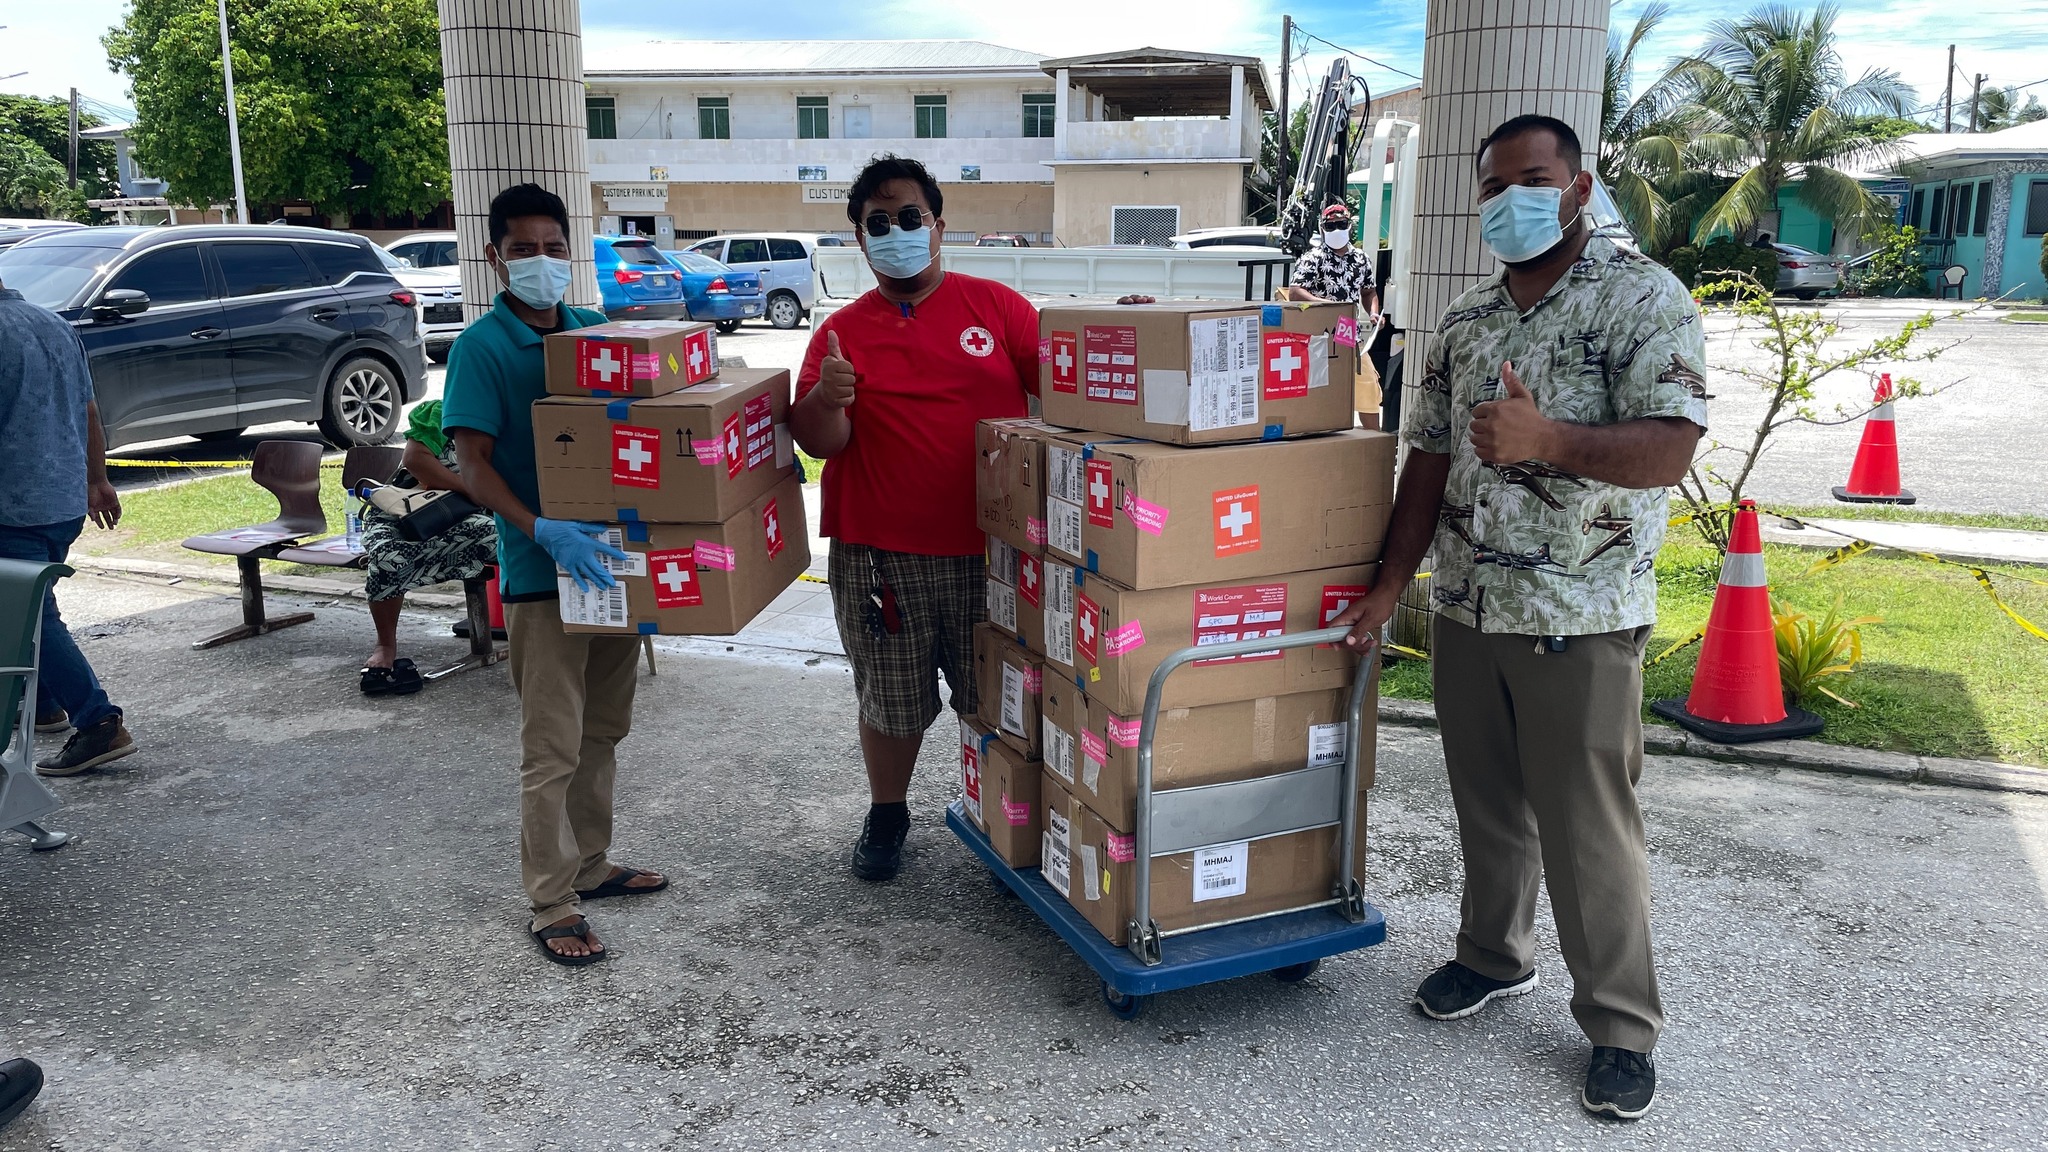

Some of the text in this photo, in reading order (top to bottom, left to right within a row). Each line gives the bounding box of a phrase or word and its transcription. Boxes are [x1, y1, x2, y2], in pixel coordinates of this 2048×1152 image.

[602, 188, 631, 198] CUSTOMER
[1337, 322, 1353, 340] PA
[1215, 490, 1258, 503] UNITED LifeGuard
[1124, 494, 1136, 516] PA
[1136, 505, 1161, 521] PRIORITY
[1207, 593, 1244, 602] World Courier
[1105, 637, 1116, 651] PA
[1108, 720, 1120, 739] PA
[1081, 733, 1091, 750] PA
[1315, 750, 1344, 761] MHMAJ
[1108, 838, 1118, 856] PA
[1203, 855, 1233, 867] MHMAJ
